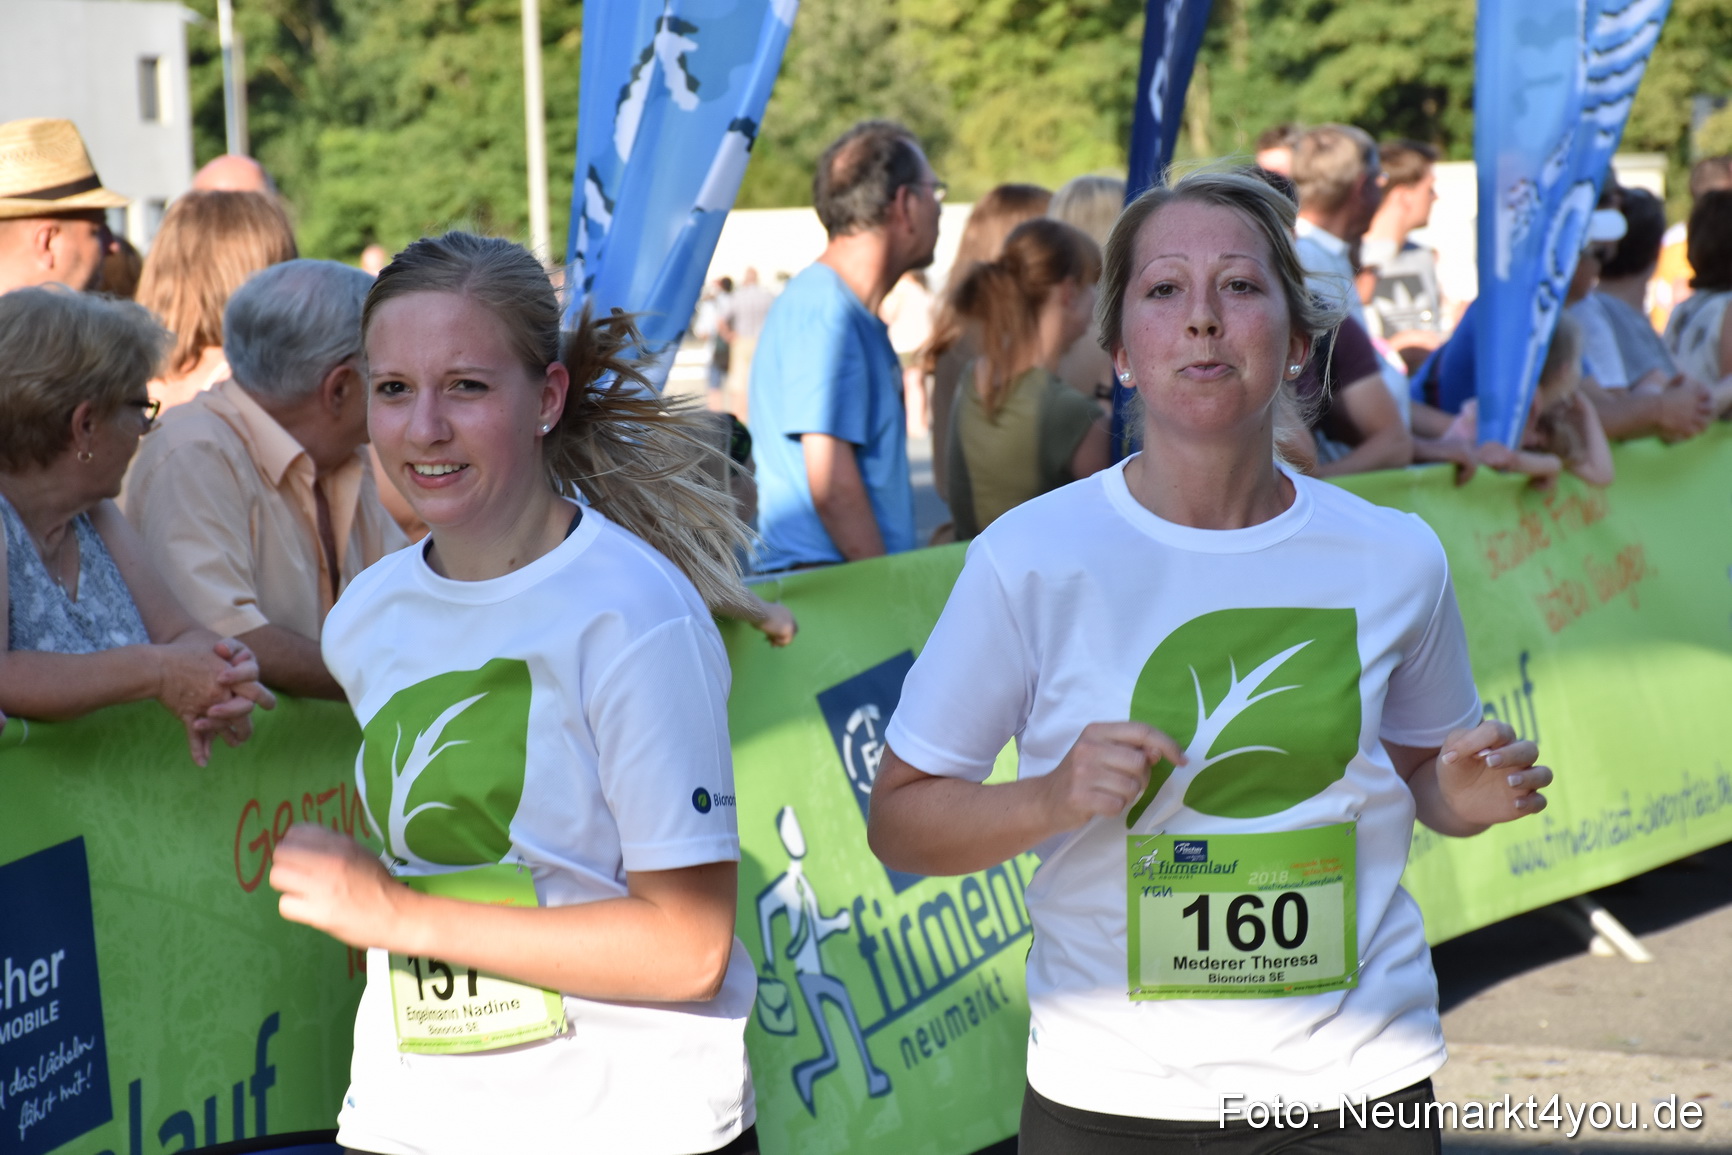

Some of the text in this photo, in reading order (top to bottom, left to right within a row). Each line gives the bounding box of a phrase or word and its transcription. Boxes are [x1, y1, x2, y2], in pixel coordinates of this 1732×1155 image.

[1158, 859, 1239, 874] firmenlauf
[1248, 870, 1289, 885] 2018
[1182, 891, 1309, 952] 160
[1173, 954, 1318, 970] Mederer Theresa
[0, 949, 66, 1010] her
[1208, 973, 1285, 983] Bionorica SE
[462, 998, 521, 1019] Nadine
[898, 968, 1011, 1070] neumarkt
[8, 1066, 37, 1097] das
[97, 1011, 280, 1155] lauf
